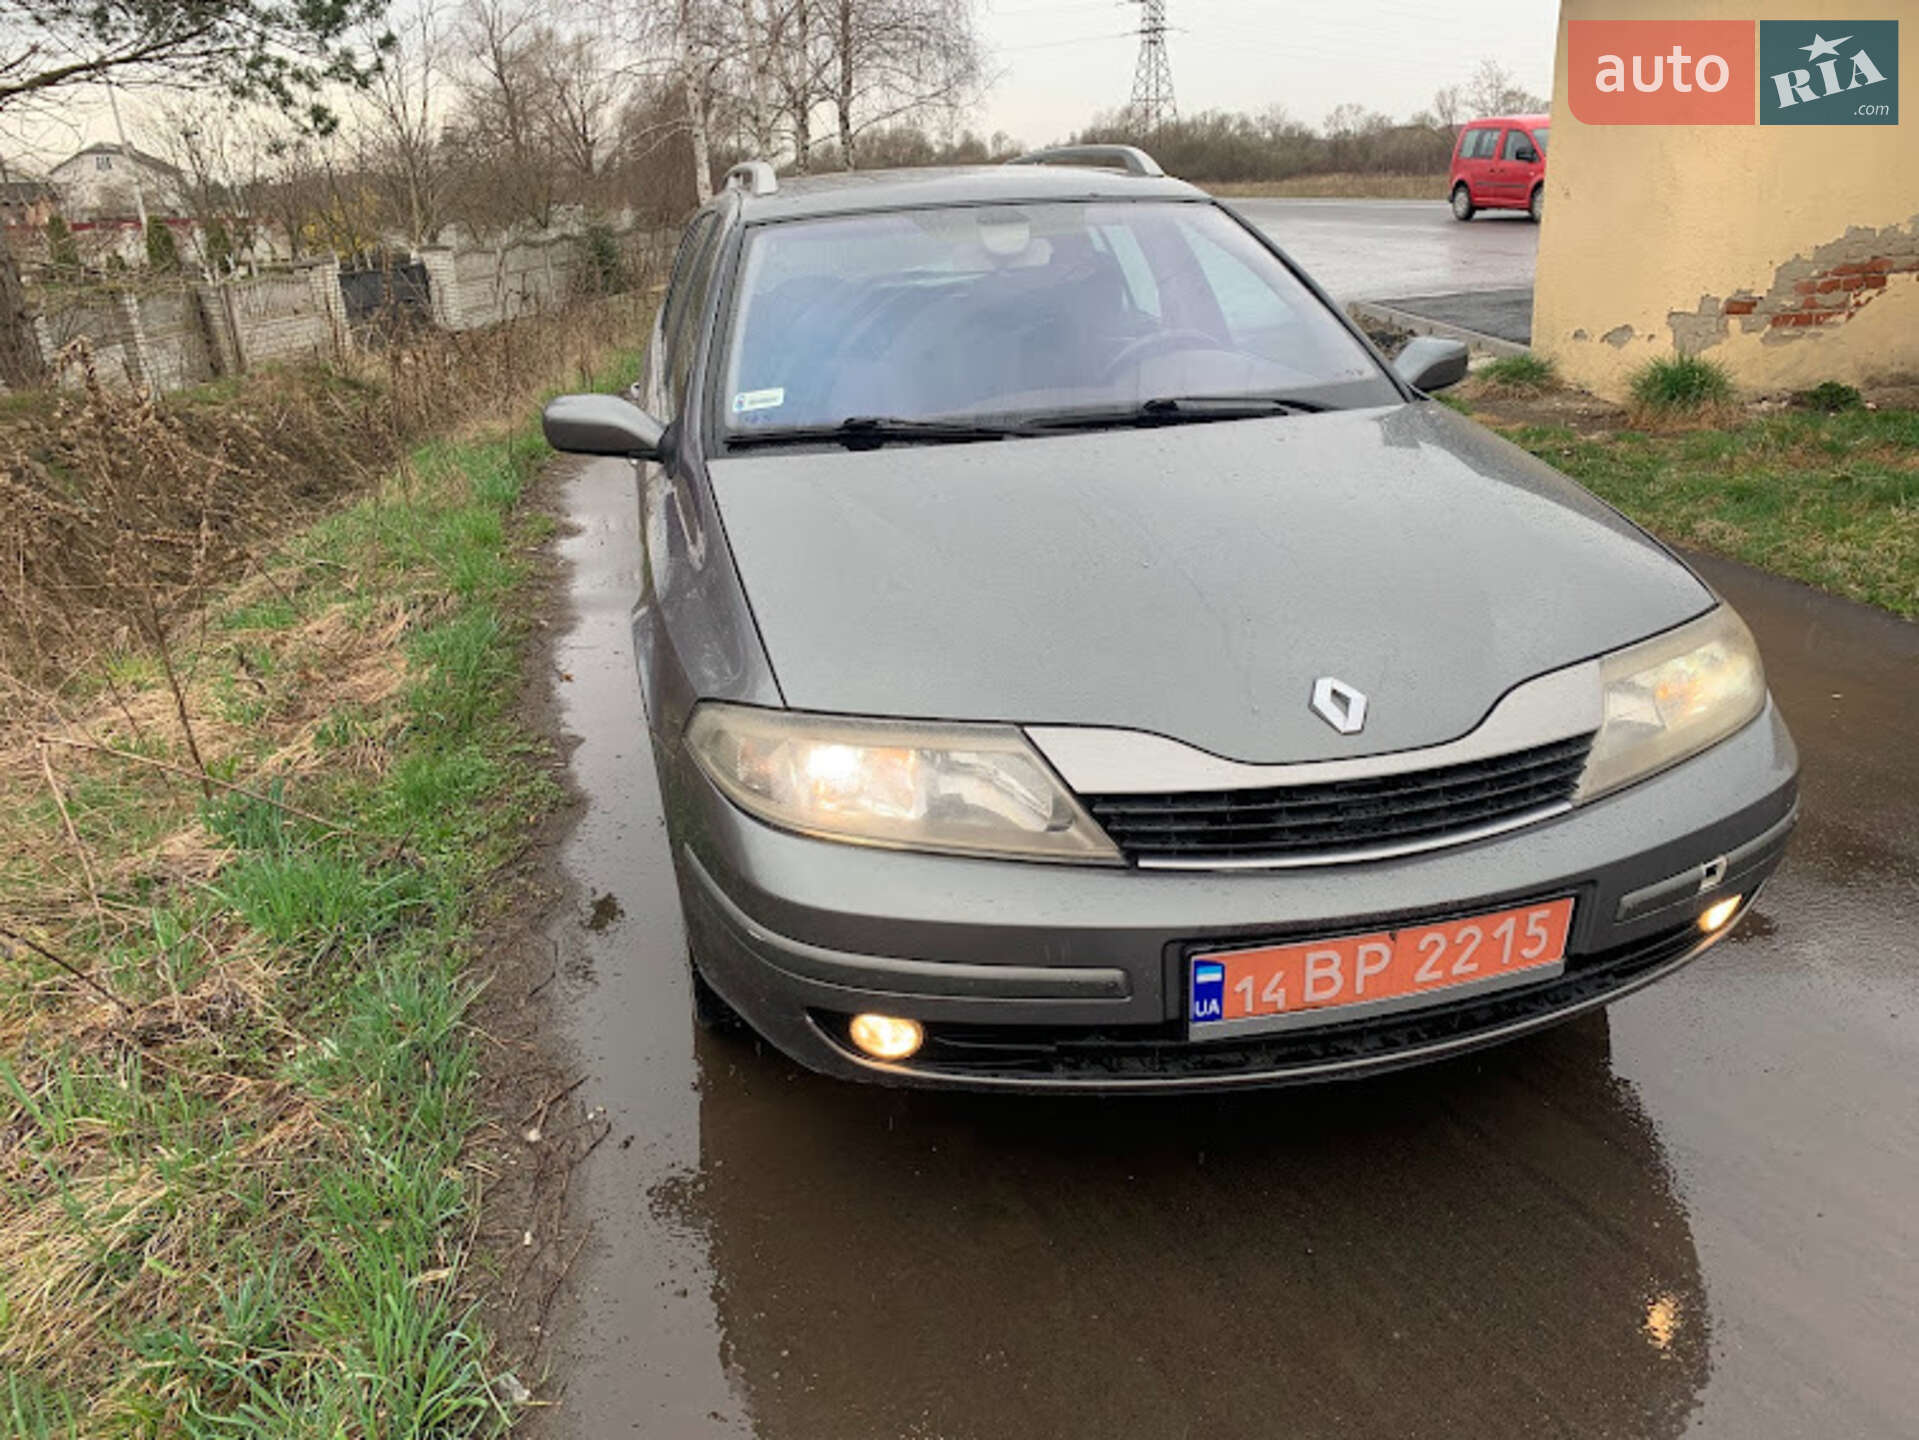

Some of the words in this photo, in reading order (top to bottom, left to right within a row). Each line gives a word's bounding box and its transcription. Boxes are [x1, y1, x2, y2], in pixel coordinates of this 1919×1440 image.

[1234, 971, 1287, 1012] 14
[1304, 942, 1392, 1003] BP
[1413, 909, 1551, 983] 2215
[1195, 999, 1221, 1018] UA
